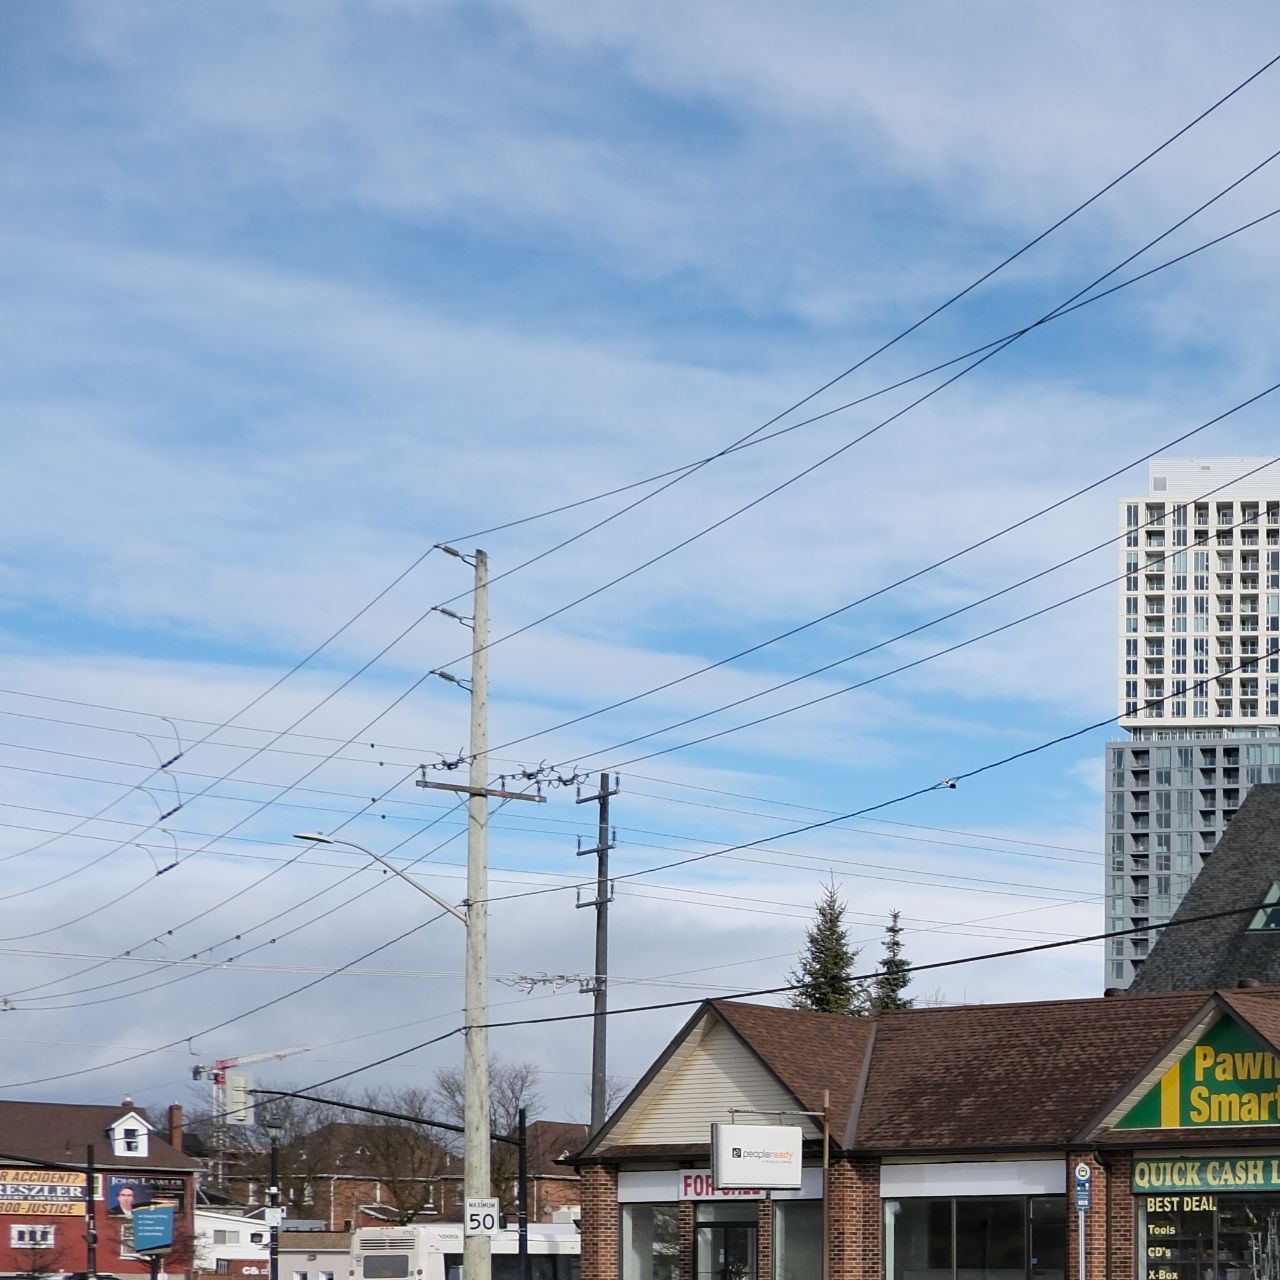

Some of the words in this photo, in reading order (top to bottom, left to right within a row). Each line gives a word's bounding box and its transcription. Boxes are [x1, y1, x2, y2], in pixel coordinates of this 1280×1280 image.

[12, 1172, 80, 1184] ACCIDENT?
[1134, 1161, 1202, 1189] QUICK
[1206, 1160, 1265, 1186] CASH
[1146, 1197, 1180, 1212] BEST
[1183, 1196, 1217, 1211] DEAL
[469, 1214, 495, 1230] 50
[1148, 1225, 1176, 1235] Tools
[1148, 1247, 1172, 1258] CD's
[1148, 1270, 1179, 1280] X-Box
